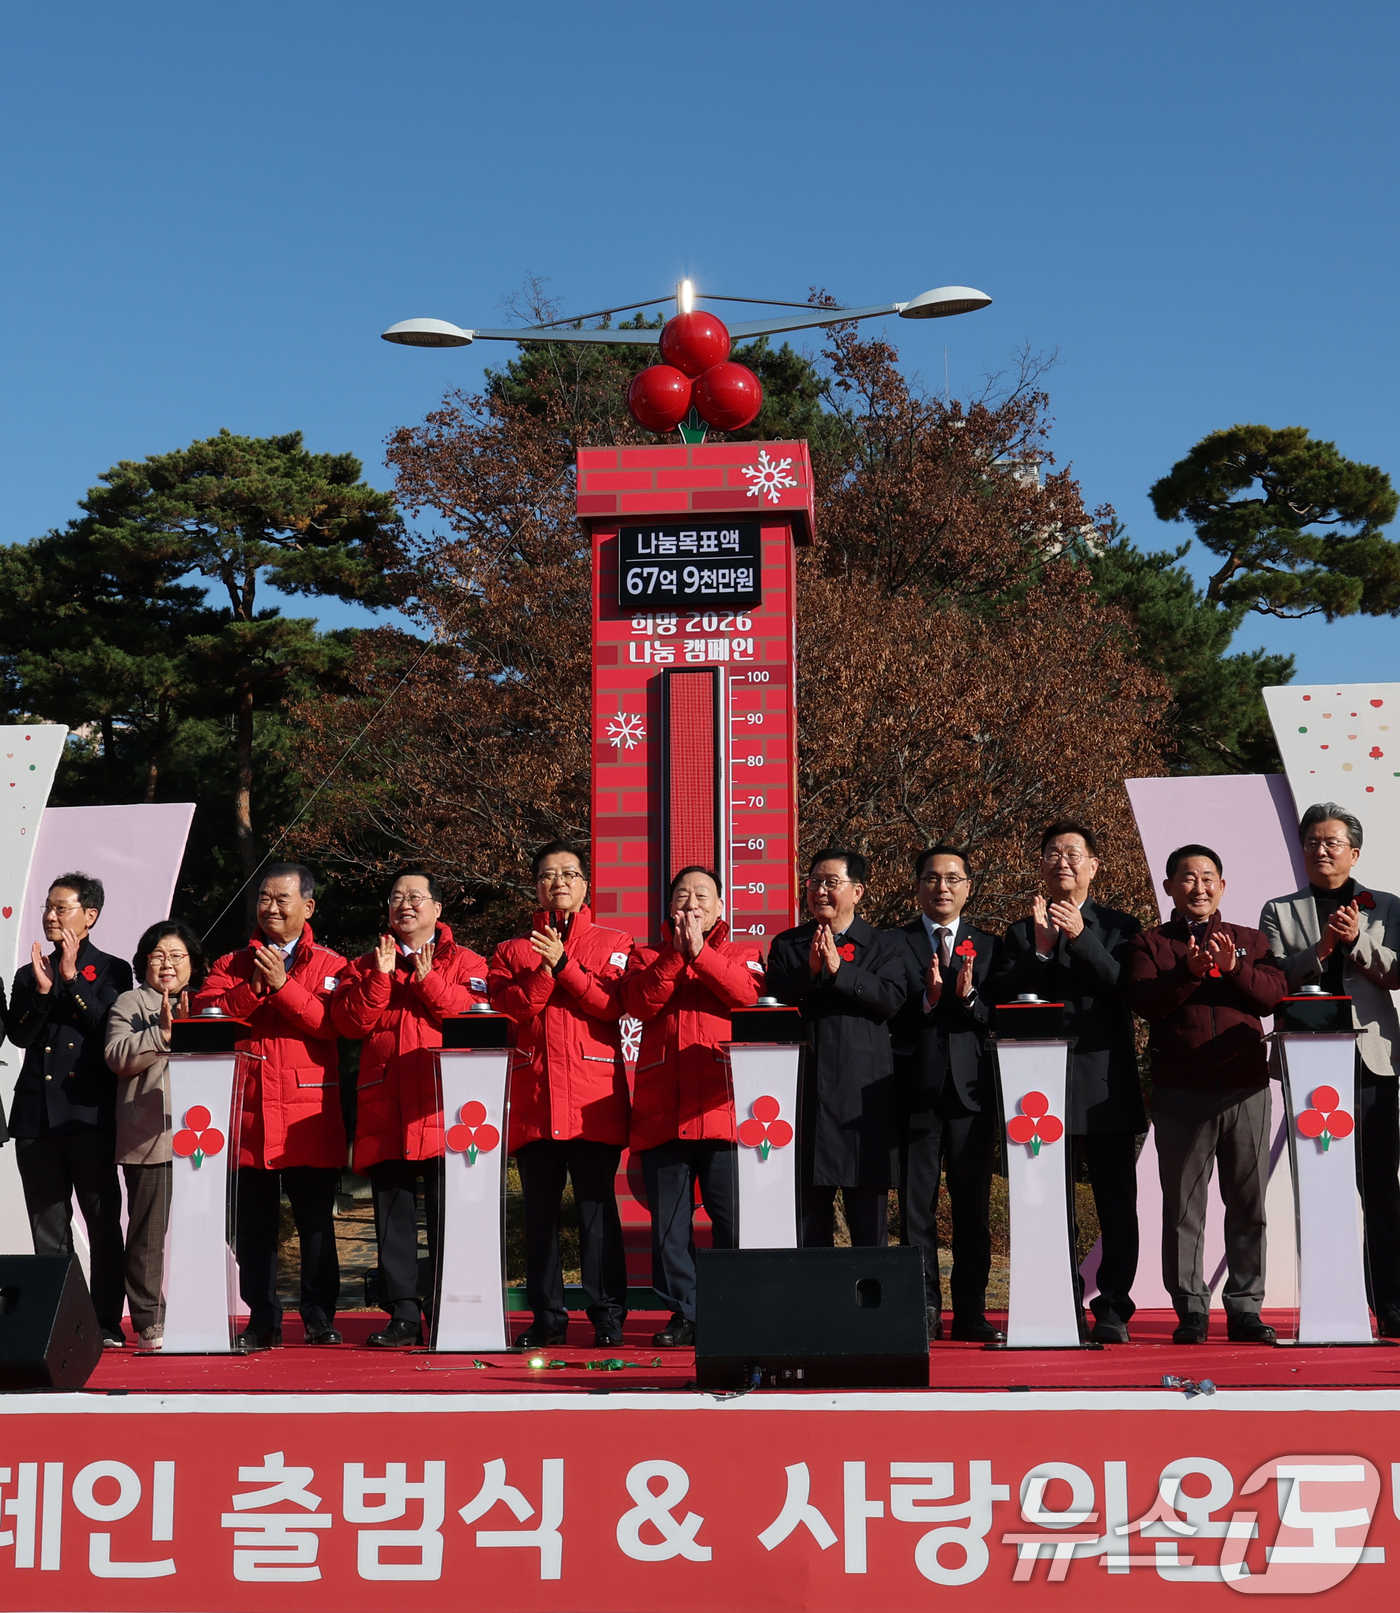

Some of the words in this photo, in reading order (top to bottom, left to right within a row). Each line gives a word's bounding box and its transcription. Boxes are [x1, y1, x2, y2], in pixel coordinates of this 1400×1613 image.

[637, 529, 740, 555] 나눔목표액
[626, 567, 677, 595] 67억
[682, 566, 754, 594] 9천만원
[630, 612, 680, 636] 희망
[685, 610, 753, 633] 2026
[629, 640, 676, 664] 나눔
[682, 637, 754, 663] 캠페인
[747, 670, 769, 683] 100
[747, 712, 763, 725] 90
[747, 755, 764, 767] 80
[748, 795, 764, 808] 70
[748, 838, 764, 850] 60
[748, 882, 765, 894] 50
[748, 923, 765, 936] 40
[221, 1451, 564, 1582] 출범식
[616, 1459, 712, 1562] &
